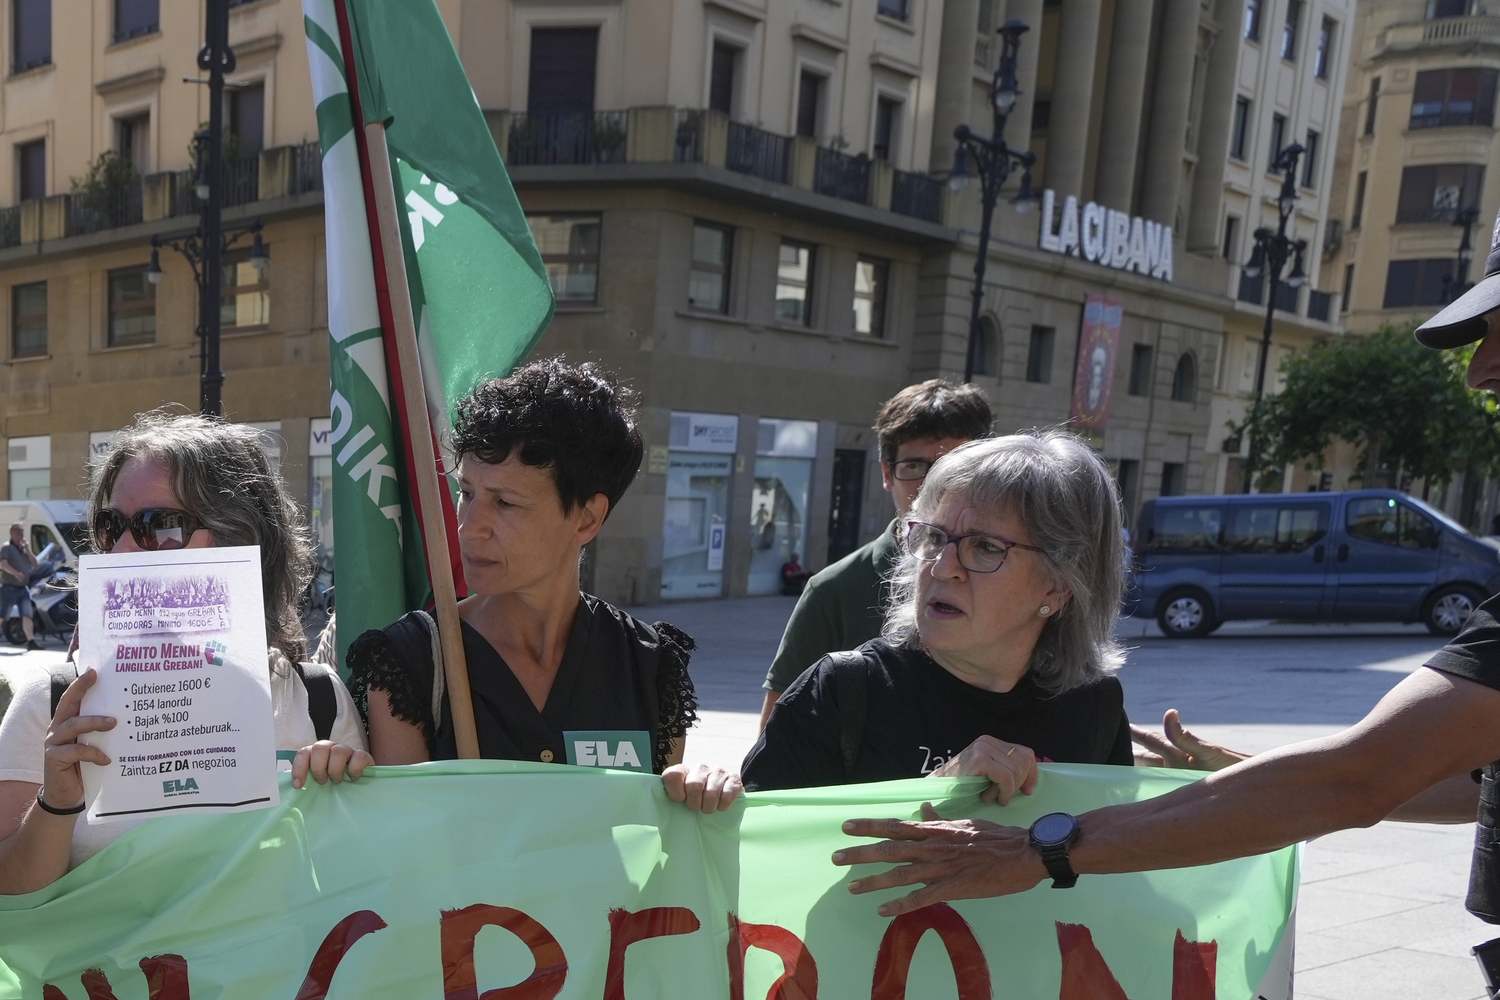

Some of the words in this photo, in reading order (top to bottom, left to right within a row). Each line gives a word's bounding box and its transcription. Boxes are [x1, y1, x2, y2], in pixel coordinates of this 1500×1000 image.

[1040, 188, 1080, 257] LA
[1082, 201, 1173, 283] CUBANA
[108, 610, 131, 618] BENITO
[134, 609, 155, 617] MENNI
[187, 606, 216, 617] GREBAN
[108, 620, 153, 630] CUIDADORAS
[157, 620, 182, 628] MINIMO
[116, 644, 157, 660] BENITO
[160, 643, 201, 659] MENNI
[115, 662, 161, 672] LANGILEAK
[163, 660, 203, 671] GREBAN!
[131, 683, 176, 695] Gutxienez
[178, 678, 202, 692] 1600
[204, 677, 211, 688] €
[132, 699, 155, 711] 1654
[157, 696, 192, 709] lanordu
[134, 715, 159, 728] Bajak
[161, 711, 189, 724] %100
[136, 729, 179, 742] Librantza
[180, 722, 240, 737] asteburuak...
[127, 754, 146, 762] ESTÁN
[147, 751, 179, 761] FORRANDO
[180, 749, 192, 757] CON
[206, 746, 236, 754] CUIDADOS
[574, 741, 642, 767] ELA
[120, 765, 157, 777] Zaintza
[159, 761, 172, 774] EZ
[174, 759, 189, 772] DA
[192, 756, 237, 771] negozioa
[162, 777, 199, 793] ELA
